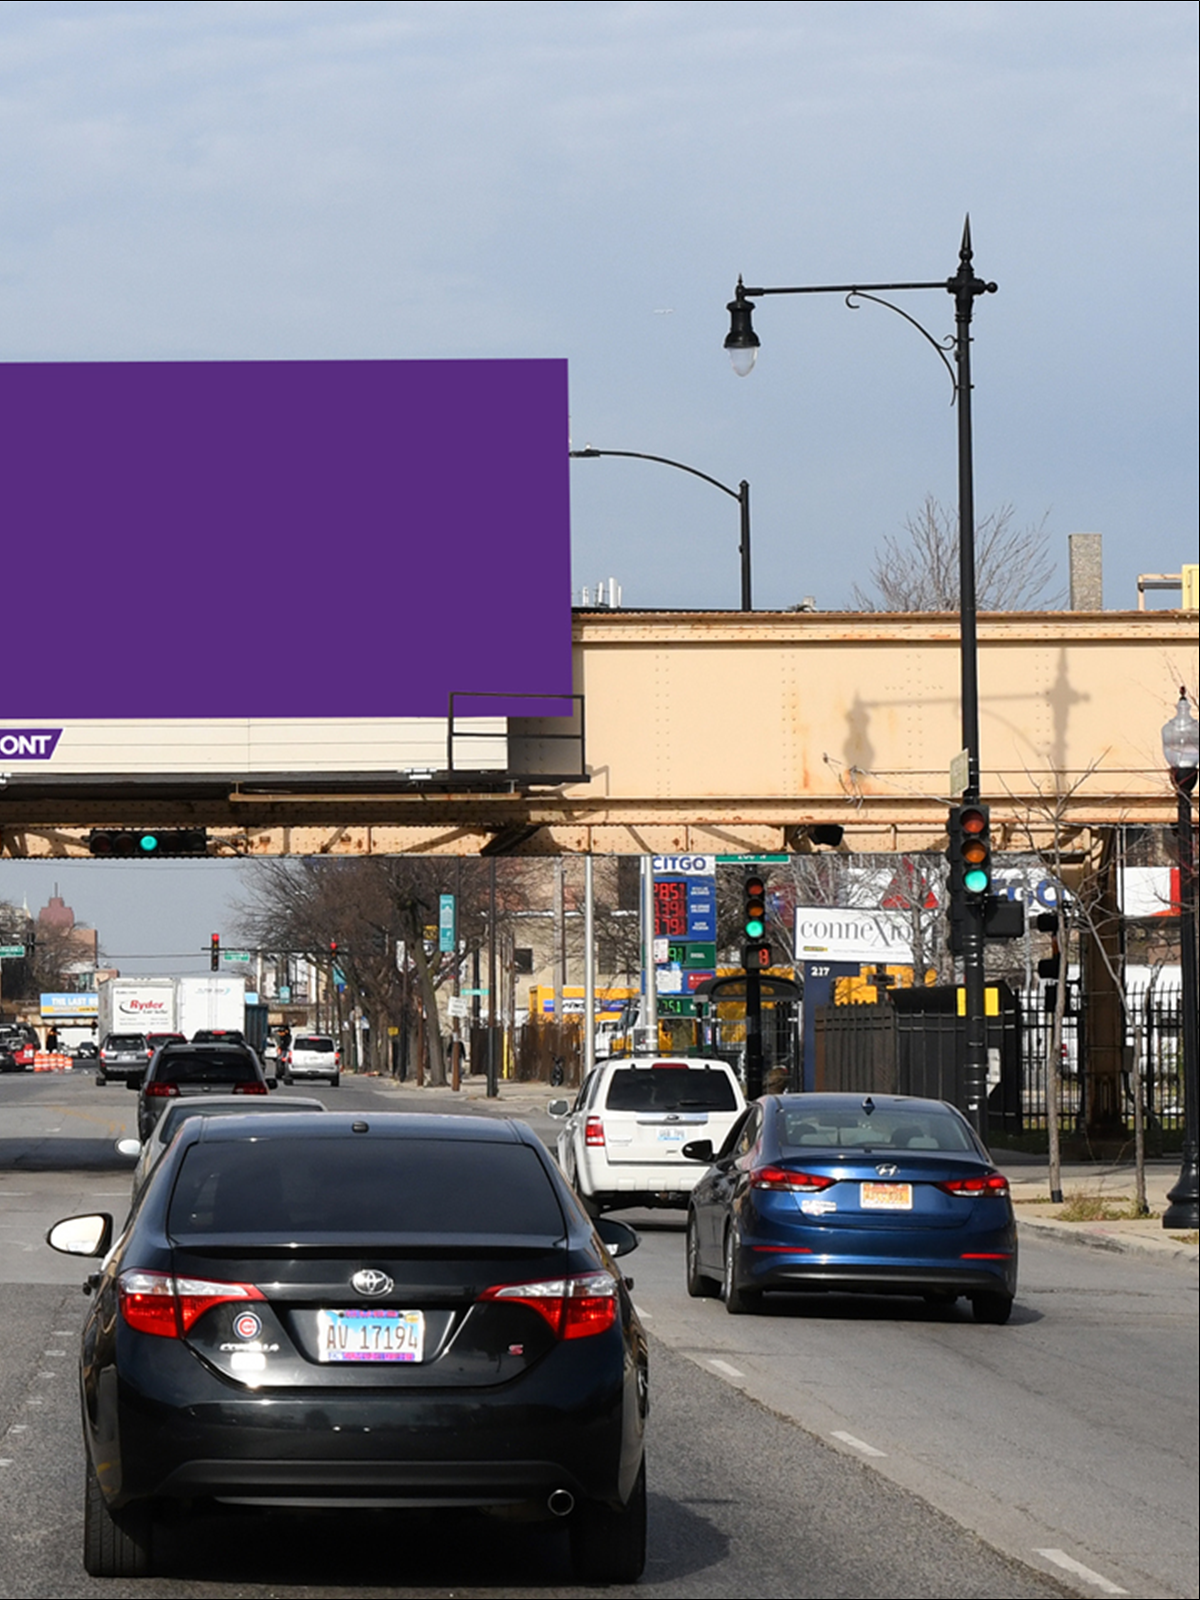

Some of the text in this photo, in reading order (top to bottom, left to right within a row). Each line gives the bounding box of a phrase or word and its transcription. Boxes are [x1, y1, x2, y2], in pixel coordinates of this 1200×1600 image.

[653, 856, 706, 871] CITGO
[800, 916, 912, 948] conneXio
[810, 965, 831, 977] 217
[67, 997, 87, 1006] LAST
[129, 999, 164, 1011] Ryder
[326, 1324, 417, 1350] AV 17194
